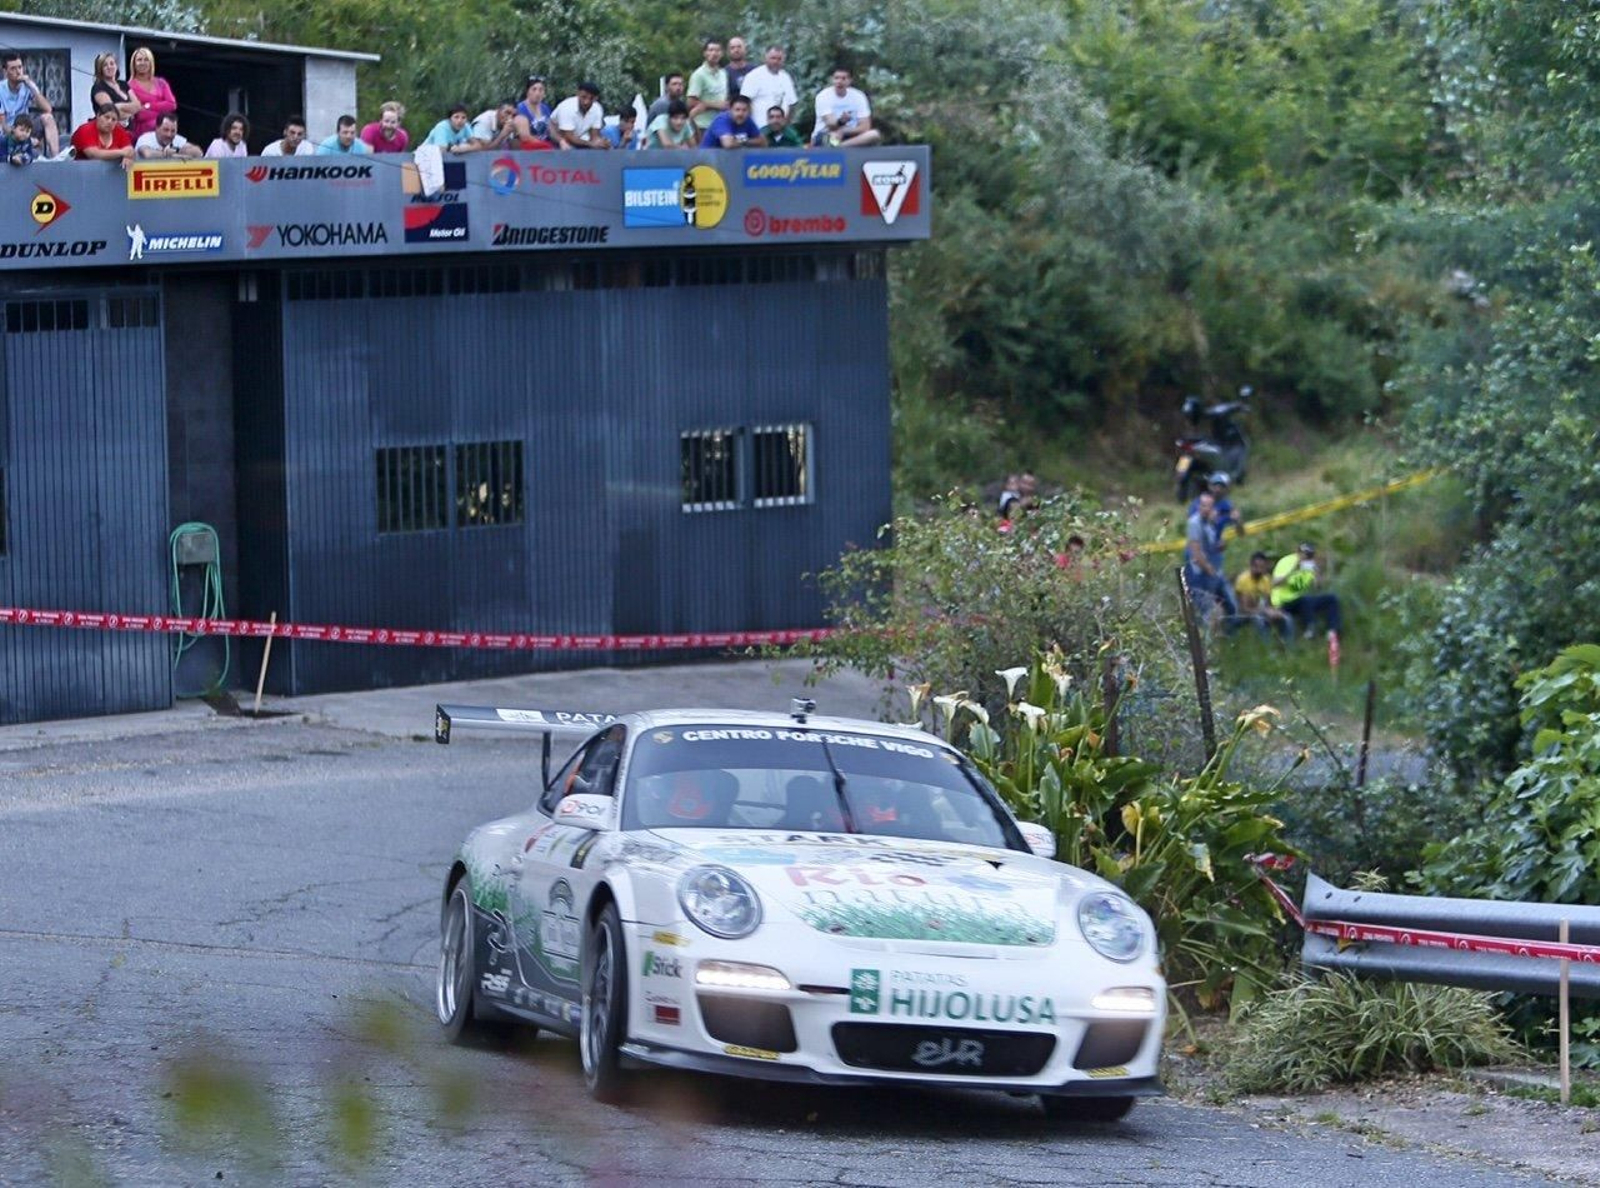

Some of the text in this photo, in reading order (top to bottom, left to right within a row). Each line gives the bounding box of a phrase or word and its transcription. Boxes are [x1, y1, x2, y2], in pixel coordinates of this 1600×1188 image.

[133, 168, 214, 192] PIRELLI
[528, 164, 601, 185] TOTAL
[746, 158, 843, 182] GOODYEAR
[624, 189, 679, 207] BILSTEIN
[276, 222, 389, 247] YOKOHAMA
[769, 214, 846, 234] brembo
[148, 235, 222, 251] MICHELIN
[491, 224, 610, 246] BRIDGESTONE
[0, 239, 107, 259] DUNLOP
[682, 729, 934, 759] CENTRO PORSCHE VIGO
[890, 969, 971, 988] PATATAS
[890, 987, 1057, 1026] HIJOLUSA
